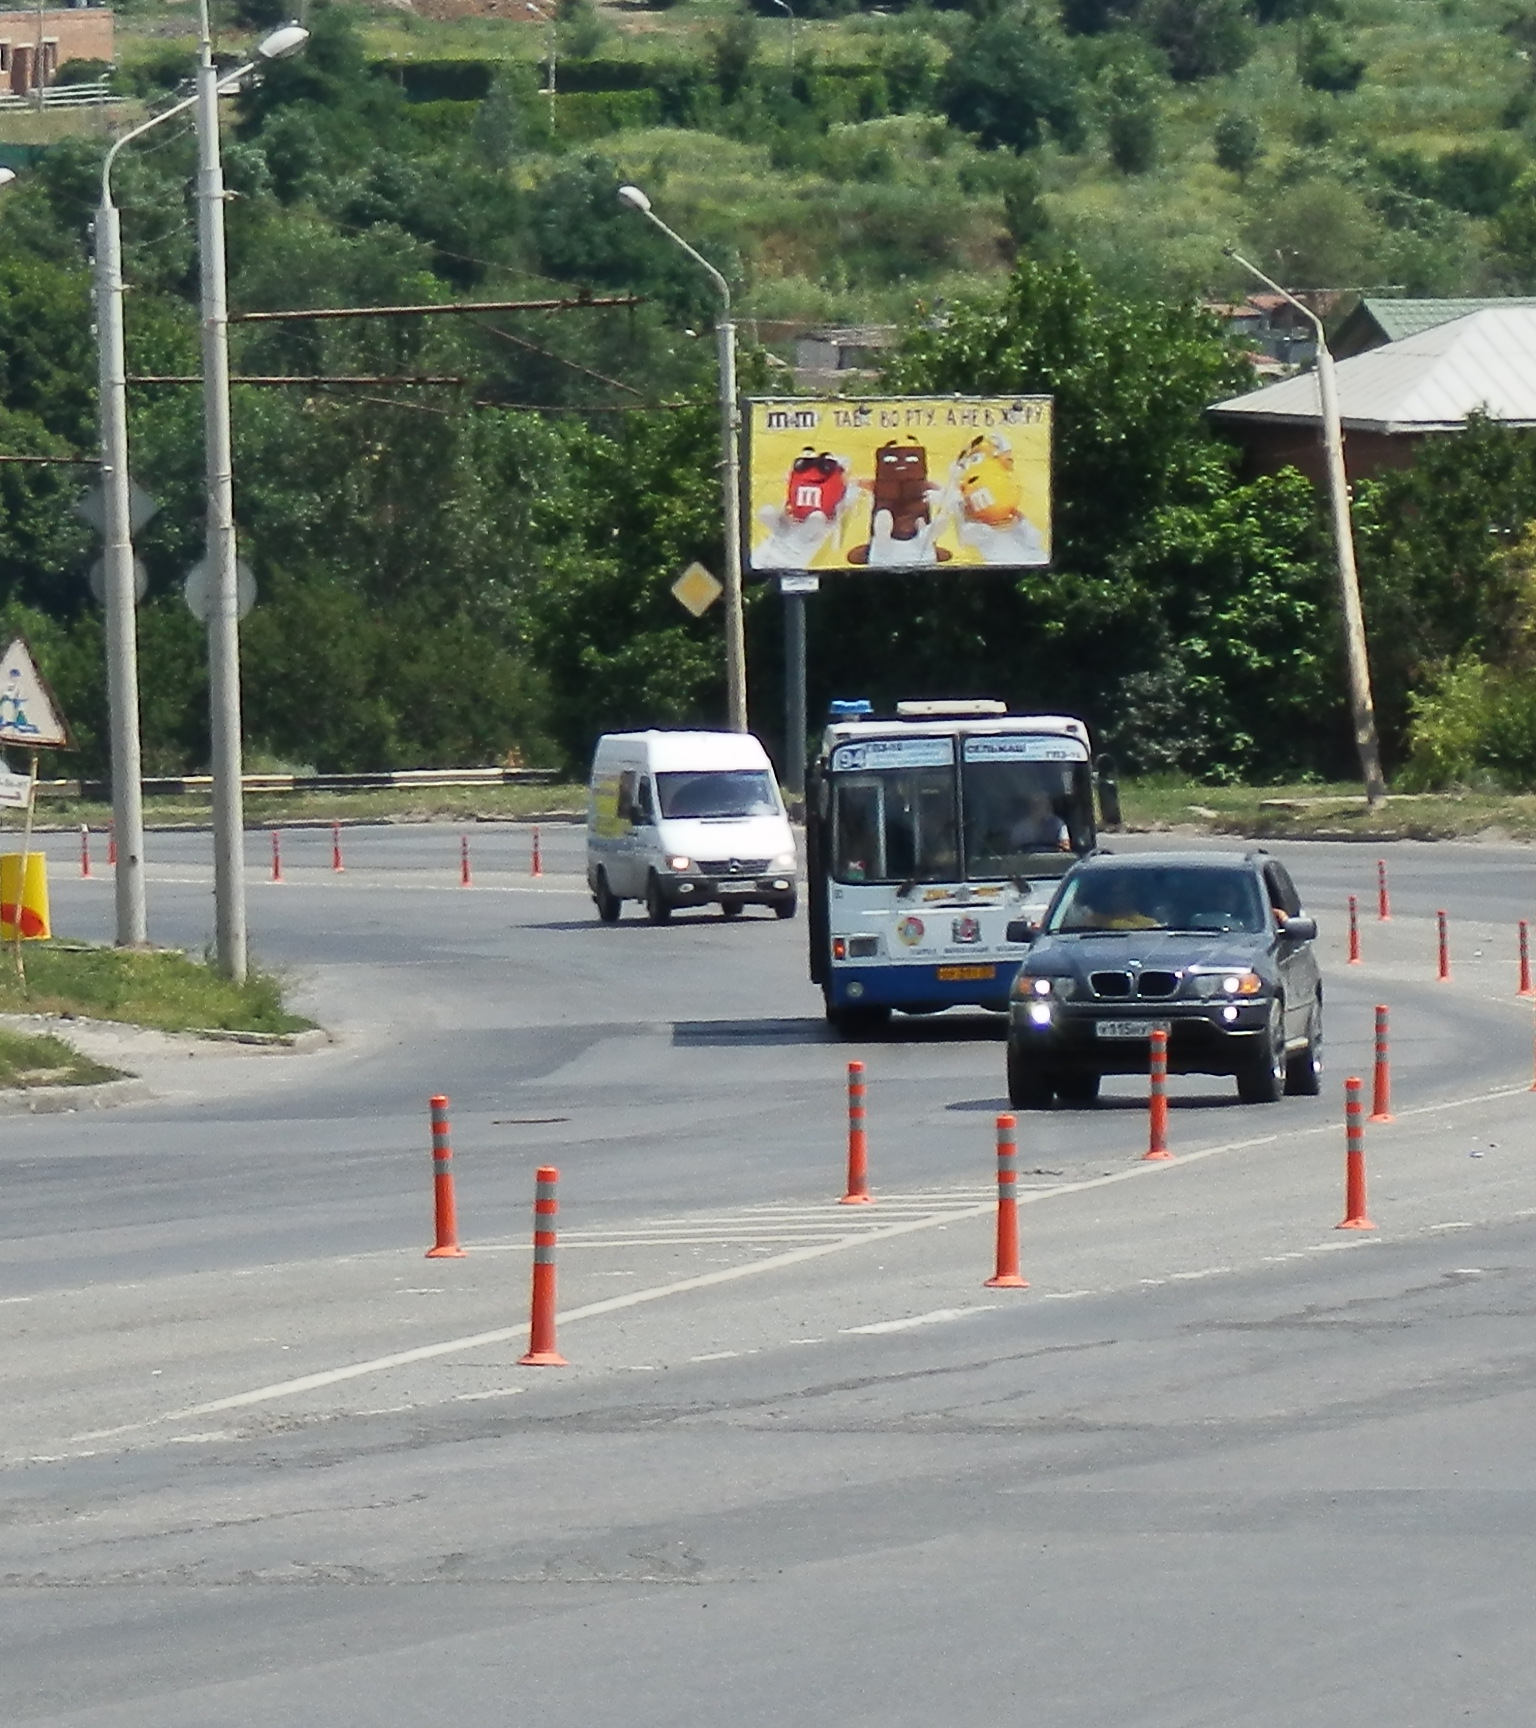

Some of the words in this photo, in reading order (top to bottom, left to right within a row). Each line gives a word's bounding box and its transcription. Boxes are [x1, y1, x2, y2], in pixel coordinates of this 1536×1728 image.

[880, 410, 900, 428] ВО
[947, 408, 957, 425] А
[961, 408, 980, 427] НЕ
[838, 747, 865, 770] 94
